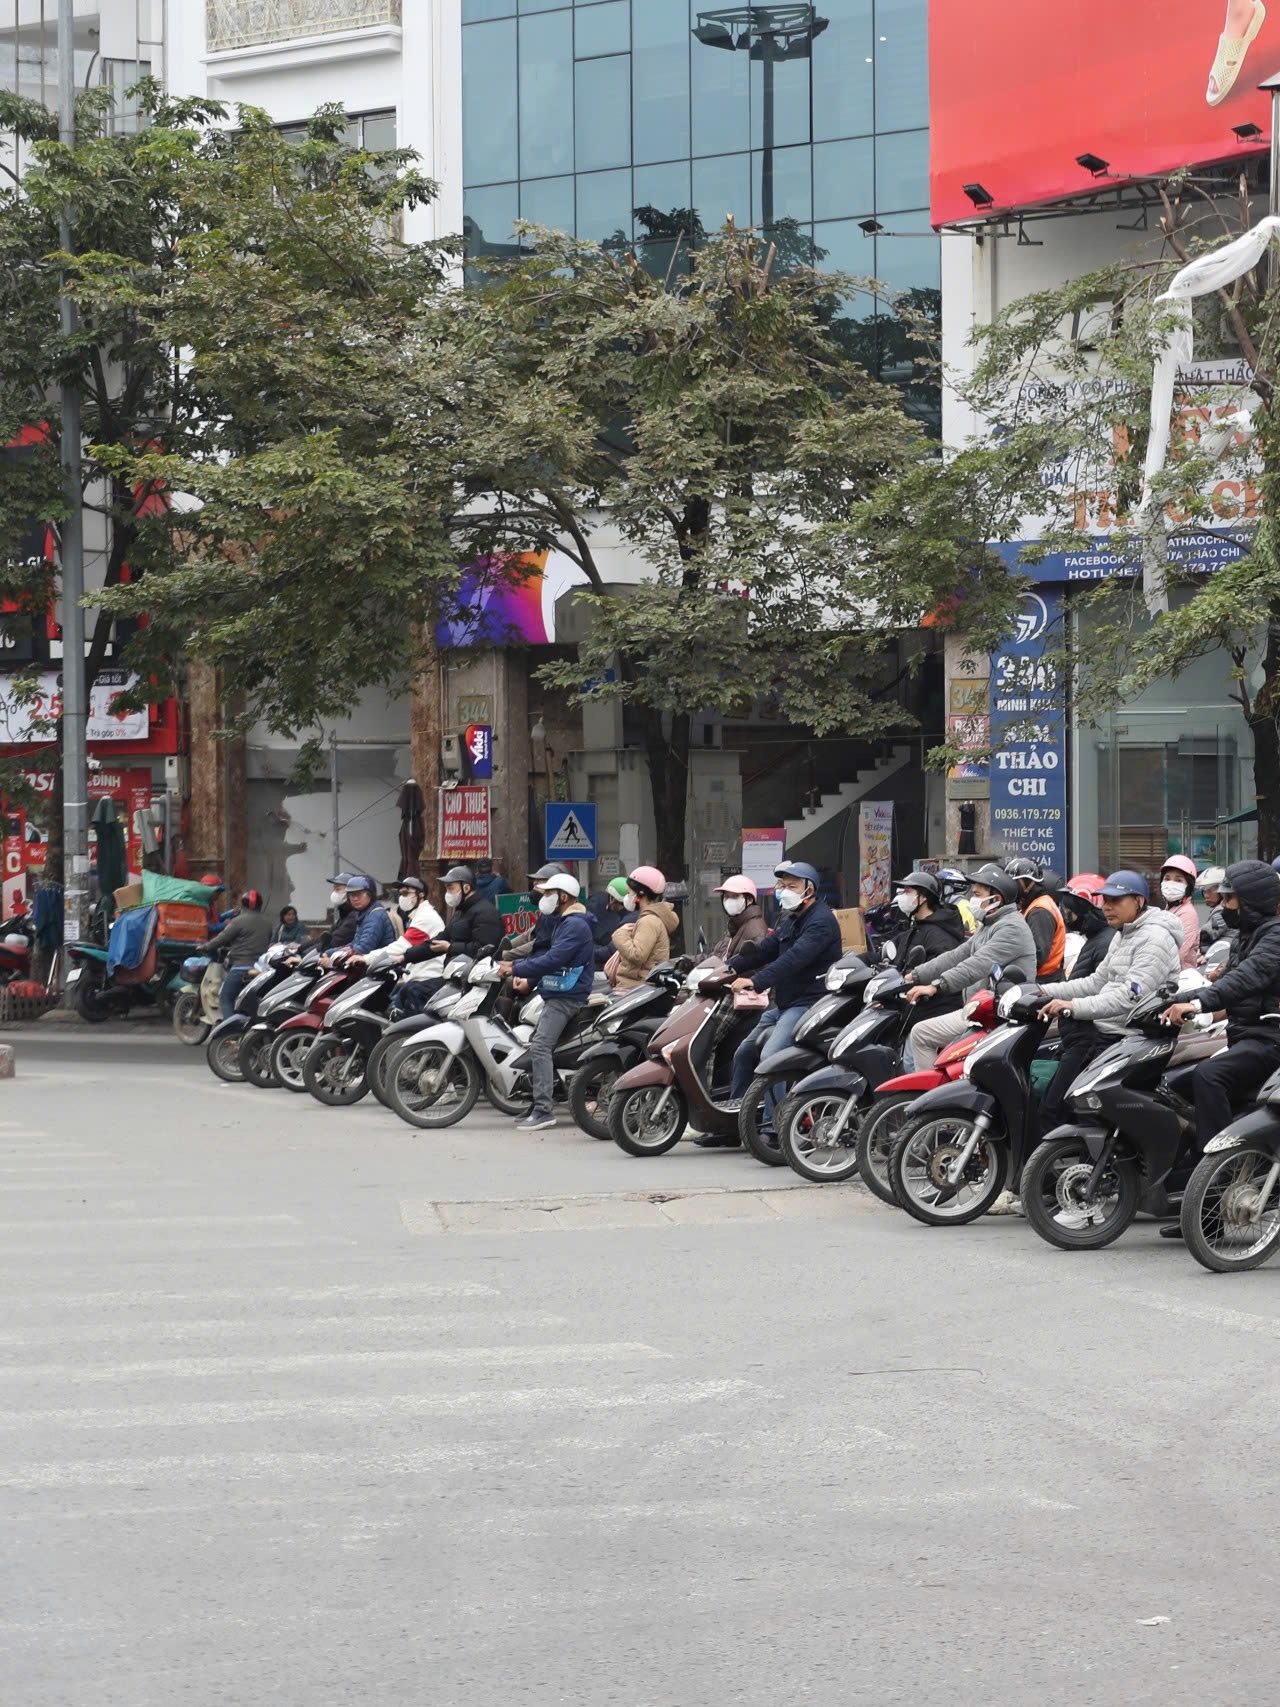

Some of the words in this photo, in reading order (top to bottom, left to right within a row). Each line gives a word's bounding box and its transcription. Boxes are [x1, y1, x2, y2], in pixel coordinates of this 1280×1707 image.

[1220, 547, 1240, 557] CHI
[997, 698, 1027, 711] MINH
[470, 730, 484, 765] Vikki
[996, 744, 1059, 770] THẢO
[1007, 778, 1047, 797] CHI
[464, 787, 487, 814] THUÊ
[994, 808, 1061, 820] 0936.179.729
[1001, 842, 1019, 852] THI
[1021, 840, 1056, 852] CÔNG
